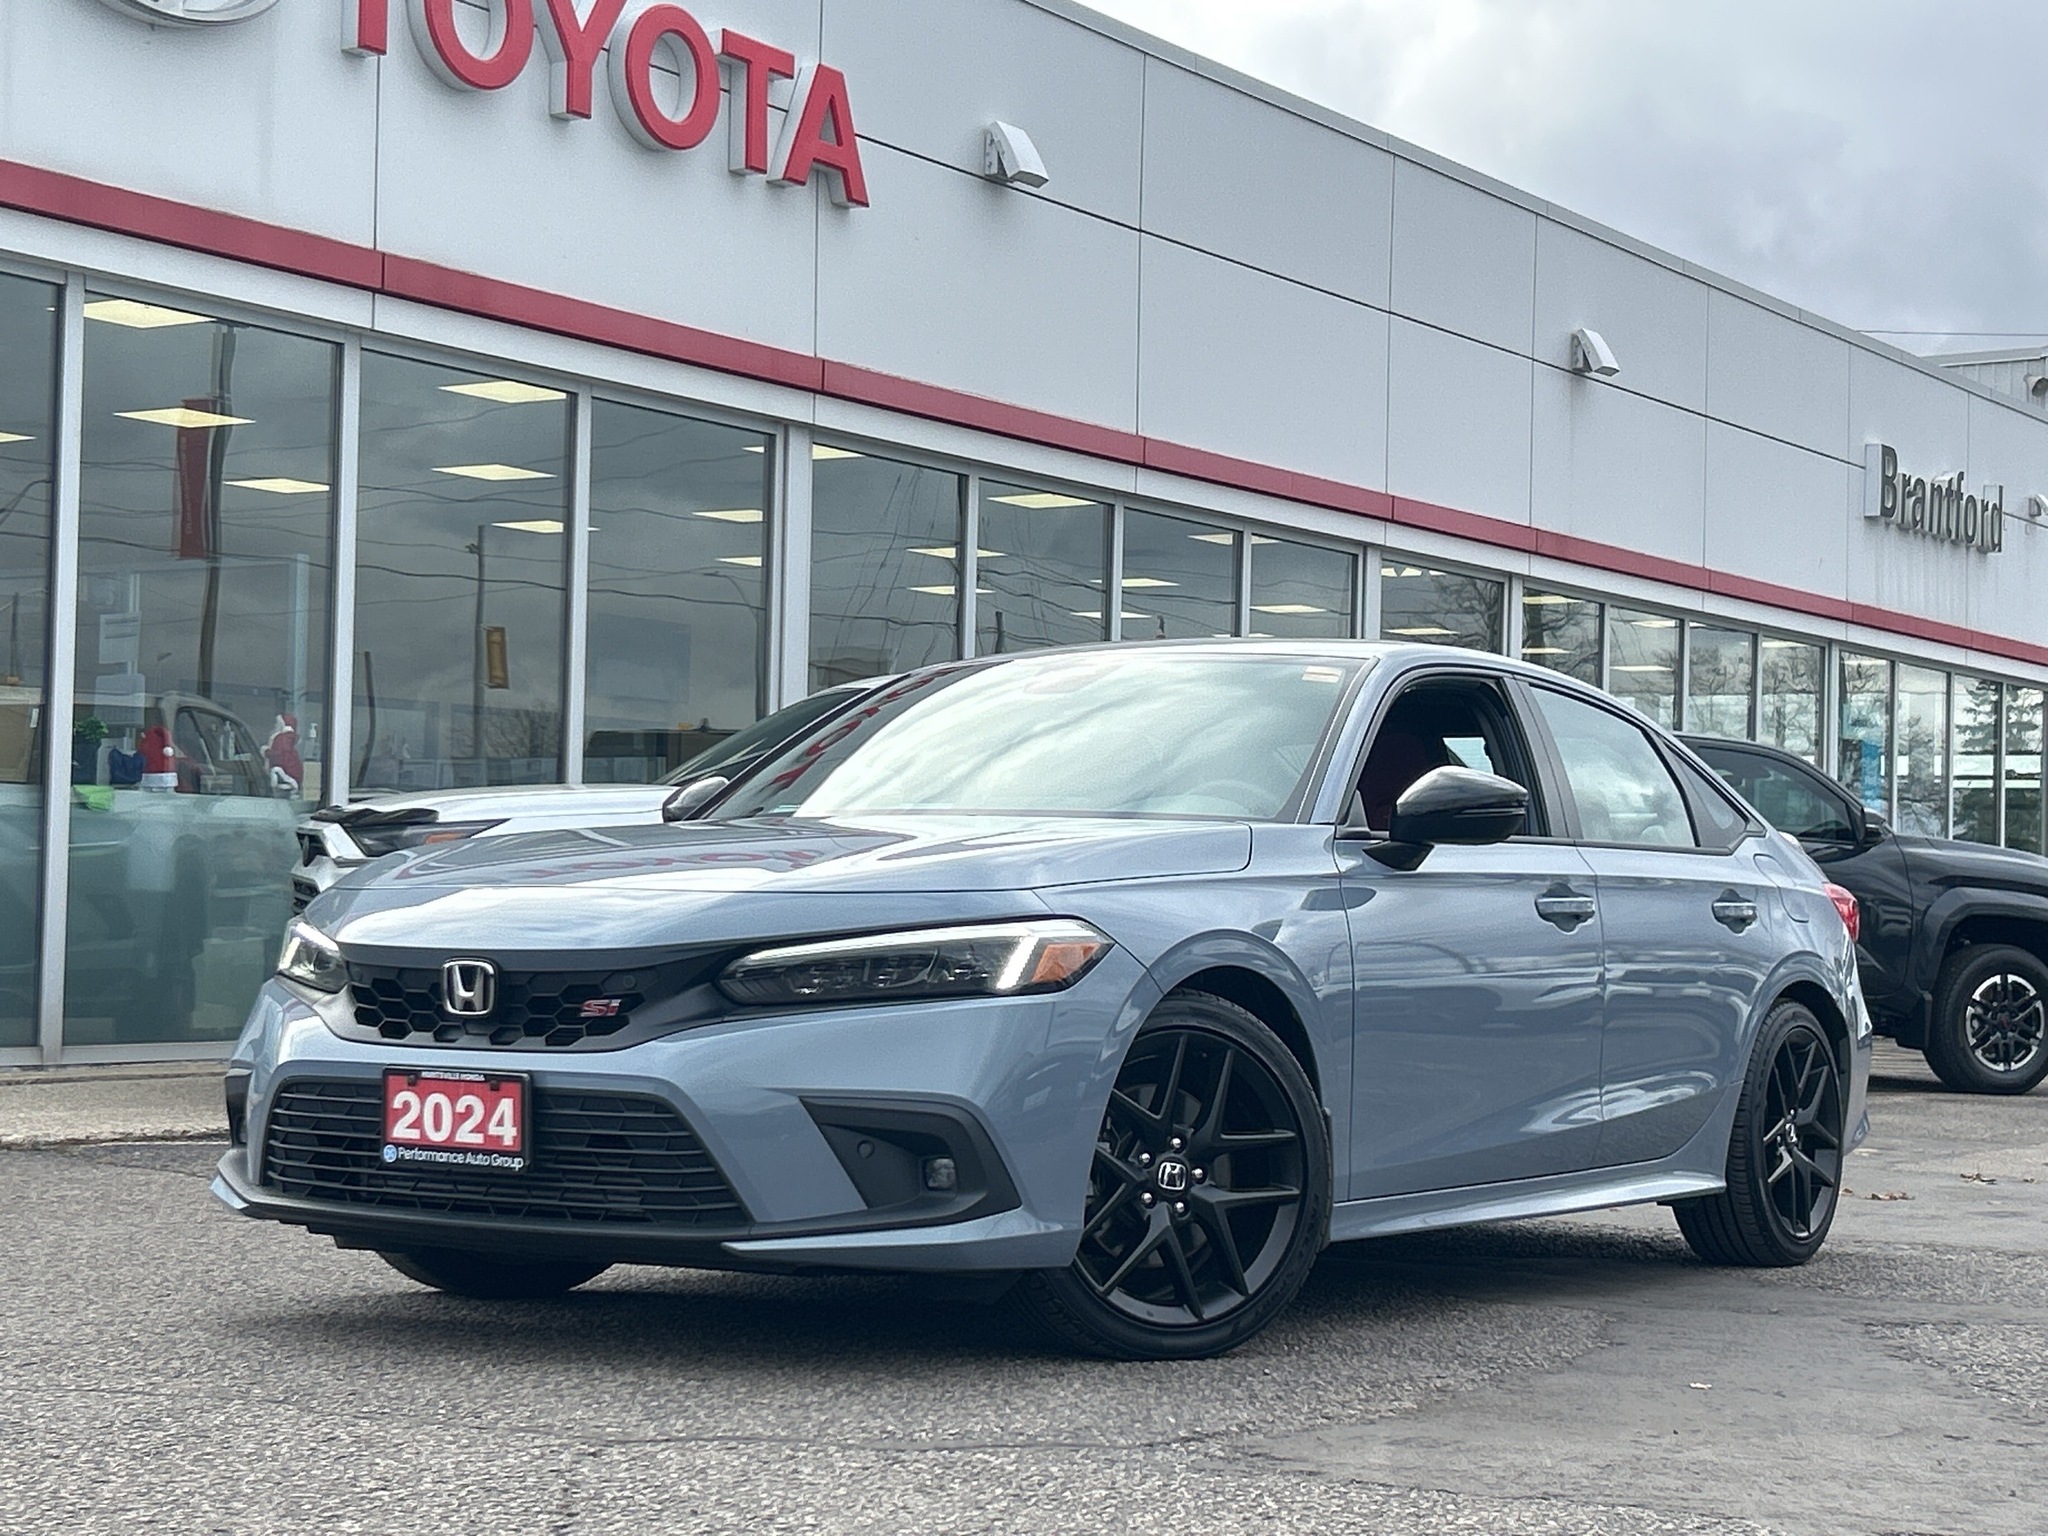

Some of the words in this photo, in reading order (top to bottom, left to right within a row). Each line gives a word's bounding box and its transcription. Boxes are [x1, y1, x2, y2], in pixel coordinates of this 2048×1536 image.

[1874, 443, 2005, 553] Brantford
[391, 1091, 517, 1146] 2024
[398, 1146, 464, 1164] Performance
[465, 1152, 490, 1166] Auto
[491, 1154, 524, 1171] Group
